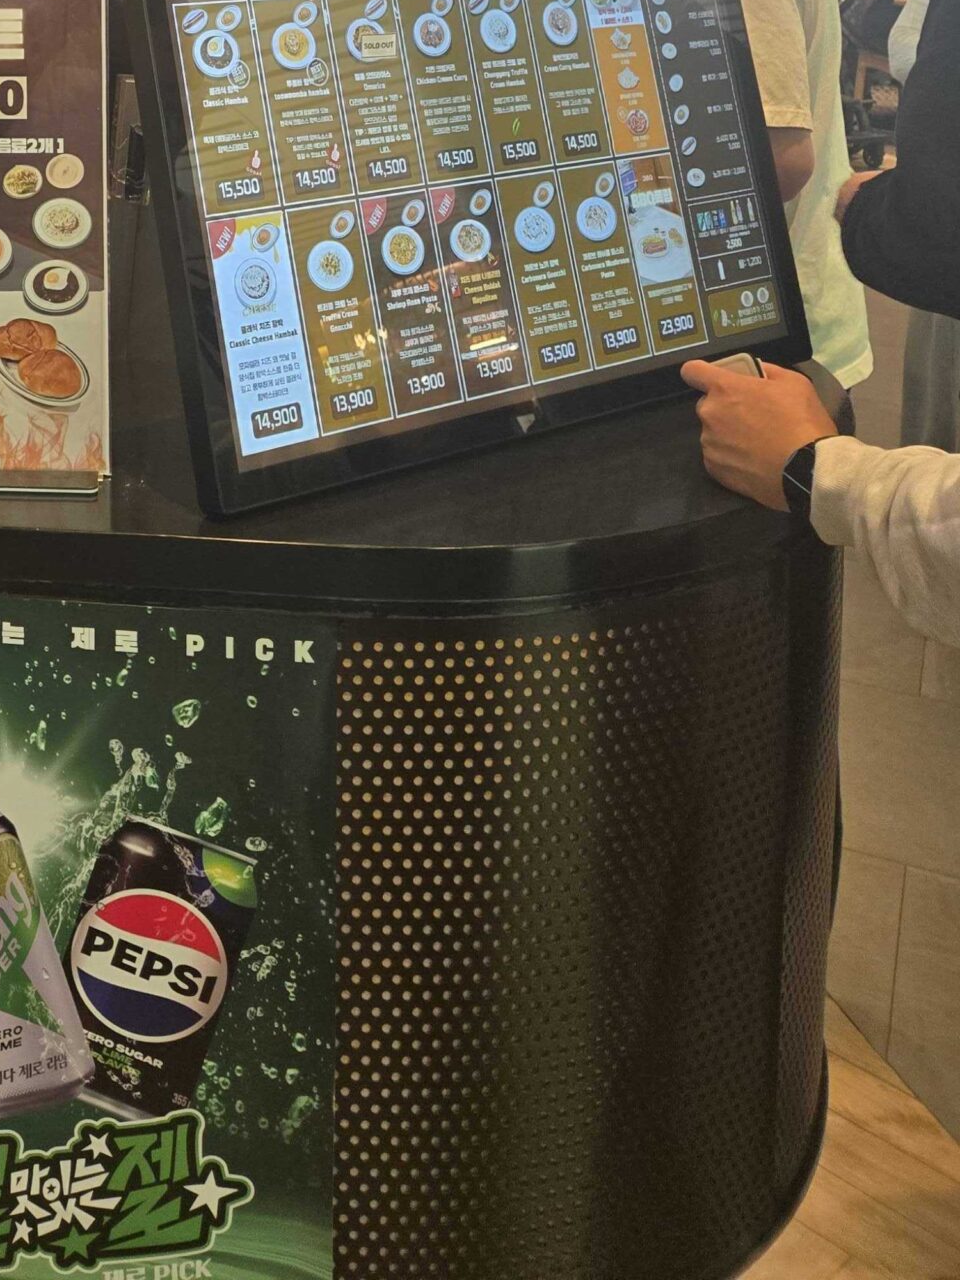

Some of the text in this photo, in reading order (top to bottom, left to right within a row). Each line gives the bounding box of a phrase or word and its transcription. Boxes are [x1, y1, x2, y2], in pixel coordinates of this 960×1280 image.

[364, 41, 394, 50] SOLD OUT
[203, 99, 224, 108] Classic
[503, 141, 537, 160] 15,500
[564, 132, 598, 151] 14,500
[368, 158, 407, 178] 14,500
[438, 148, 474, 168] 14,500
[218, 177, 261, 199] 15,500
[296, 167, 336, 189] 14,500
[438, 192, 455, 218] NEW!
[368, 204, 384, 230] NEW!
[215, 225, 234, 253] NEW!
[660, 314, 694, 337] 23,900
[229, 329, 299, 350] Classic Cheese Hambak
[603, 328, 637, 350] 13,900
[540, 342, 577, 364] 15,500
[476, 357, 513, 379] 13,900
[407, 372, 446, 395] 13,900
[333, 388, 374, 413] 13,900
[254, 405, 299, 431] 14,900
[71, 627, 139, 654] 제로
[185, 634, 315, 663] PICK
[79, 925, 218, 1005] PEPSI
[115, 1043, 164, 1069] SUGAR
[18, 1061, 45, 1080] 제로
[154, 1257, 213, 1280] PICK
